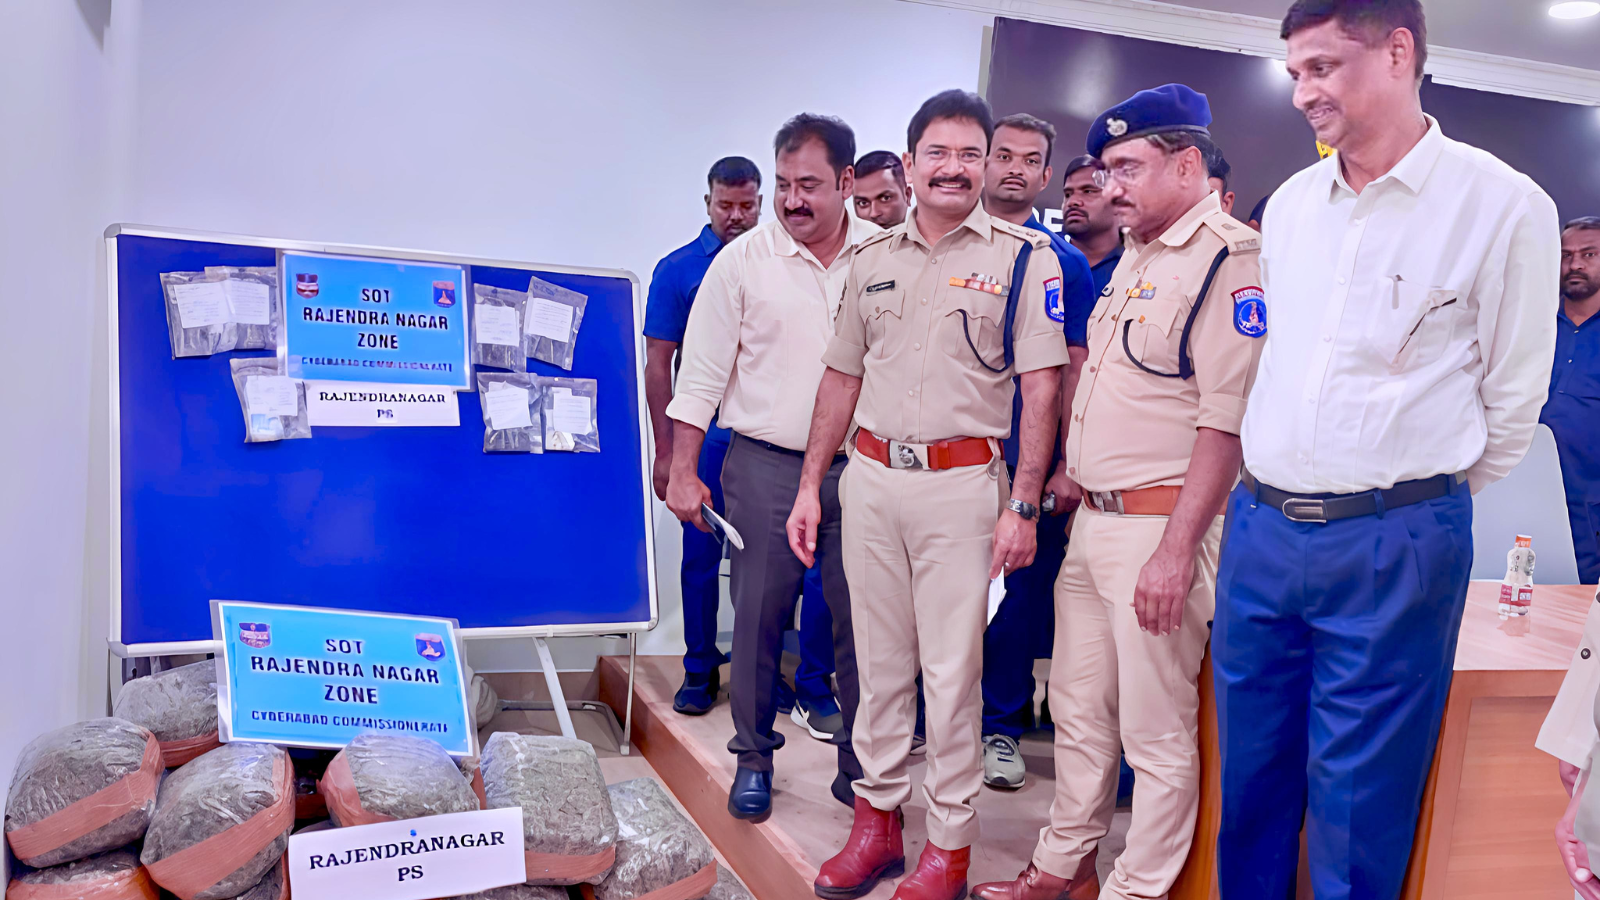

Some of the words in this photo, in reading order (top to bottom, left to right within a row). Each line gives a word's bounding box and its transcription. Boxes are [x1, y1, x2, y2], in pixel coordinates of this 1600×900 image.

[362, 288, 391, 303] SOT
[303, 307, 390, 326] RAJENDRA
[396, 312, 449, 330] NAGAR
[357, 333, 399, 349] ZONE
[325, 639, 364, 655] SOT
[250, 656, 365, 678] RAJENDRA
[372, 664, 440, 684] NAGAR
[324, 684, 379, 705] ZONE
[309, 831, 505, 870] RAJENDRANAGAR
[397, 864, 424, 882] PS
